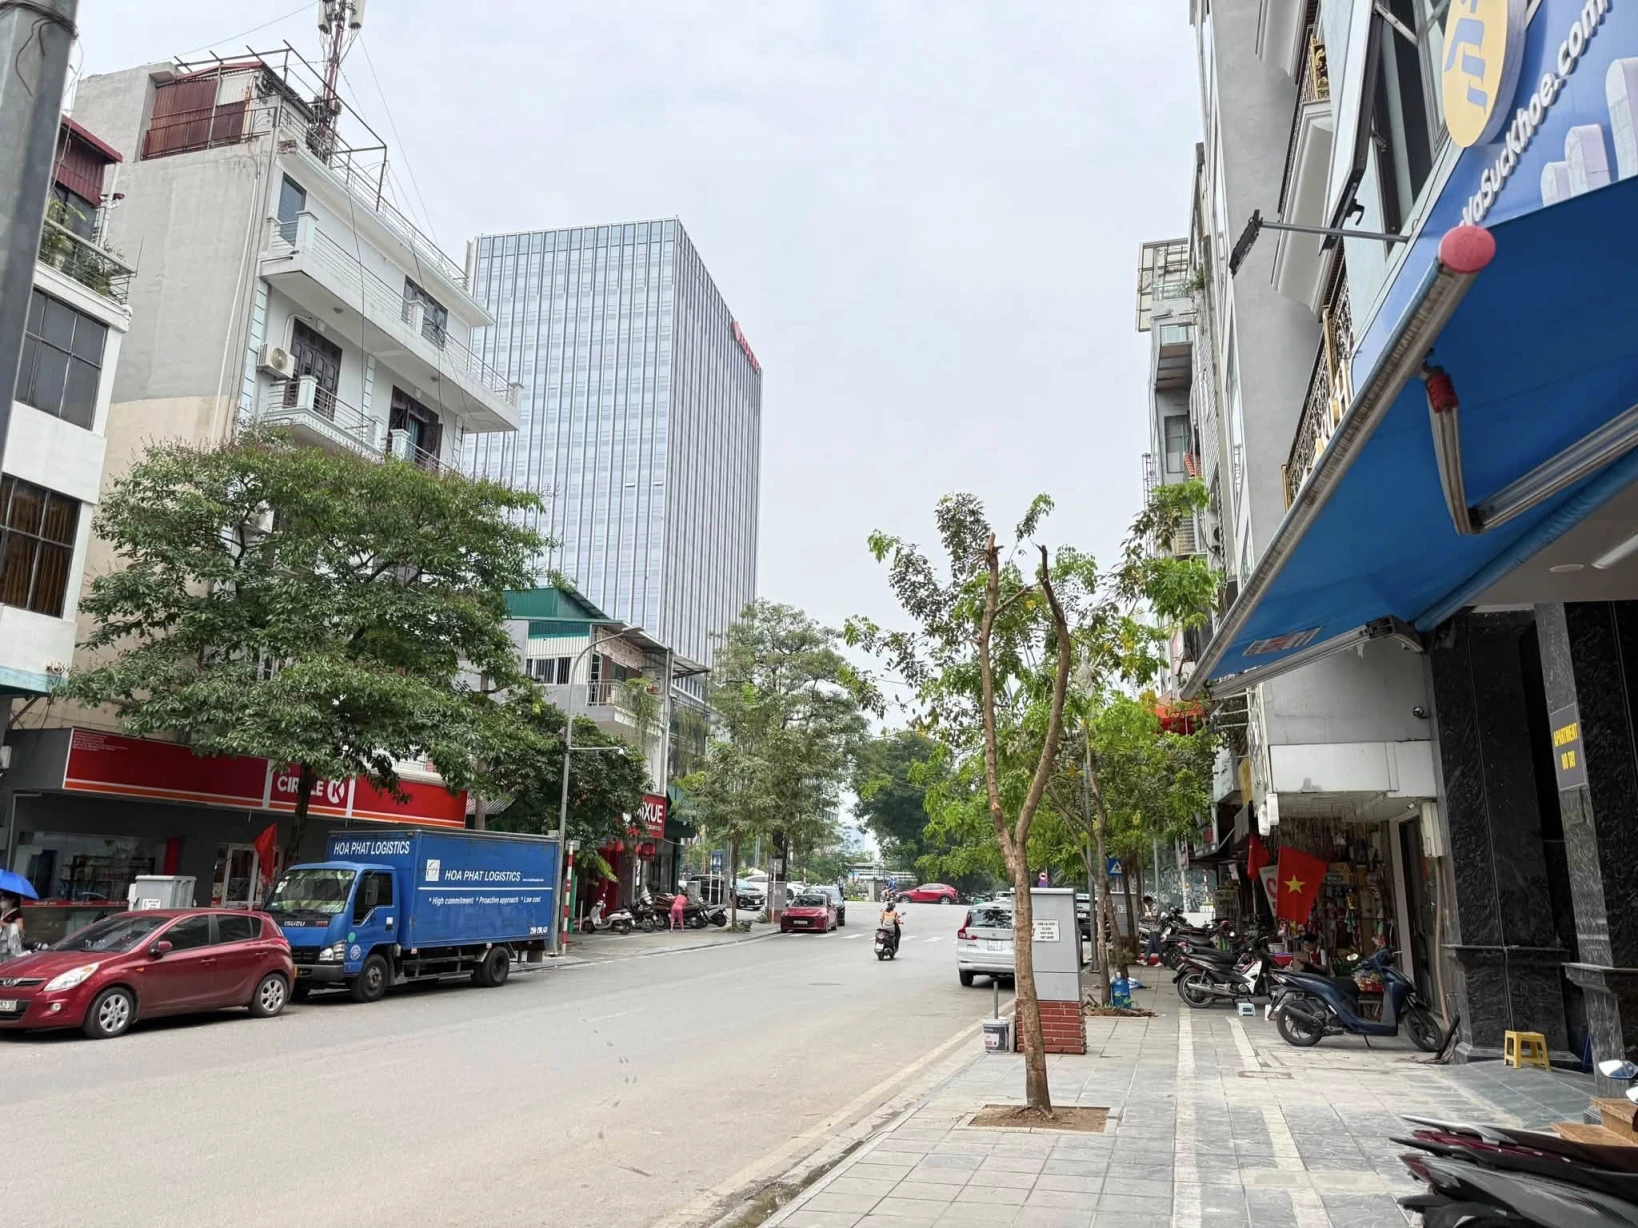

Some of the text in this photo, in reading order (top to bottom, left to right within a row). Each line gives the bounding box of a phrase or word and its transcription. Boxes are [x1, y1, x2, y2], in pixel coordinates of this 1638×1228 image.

[277, 776, 324, 797] CIRE
[333, 841, 410, 855] HOA PHAT LOGISTICS
[445, 870, 521, 882] HOA PHAT LOGISTICS
[432, 896, 445, 906] High
[444, 896, 474, 905] commitment
[479, 896, 500, 904] Proactive
